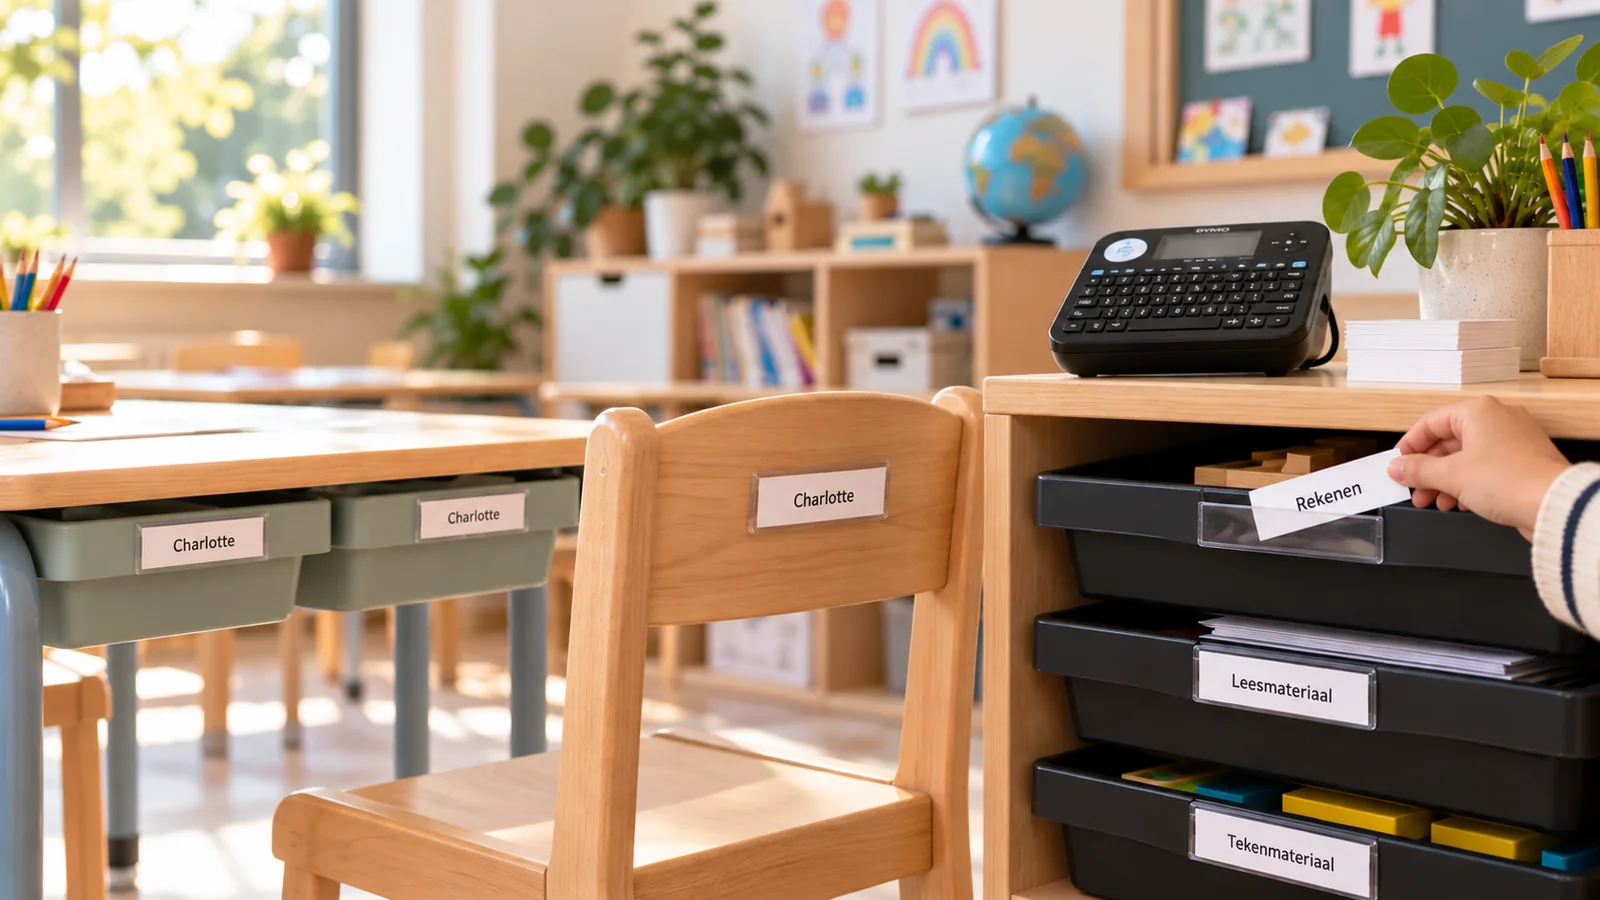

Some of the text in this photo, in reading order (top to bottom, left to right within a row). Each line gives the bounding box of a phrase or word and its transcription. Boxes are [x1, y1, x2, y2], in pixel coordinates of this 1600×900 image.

[1195, 226, 1231, 234] DYMO
[793, 489, 855, 508] Charlotte
[1295, 483, 1363, 512] Rekenen
[447, 508, 500, 525] Charlotte
[172, 535, 236, 554] Charlotte
[1232, 673, 1332, 704] Leesmateriaal
[1227, 833, 1335, 872] Tekenmateriaal
